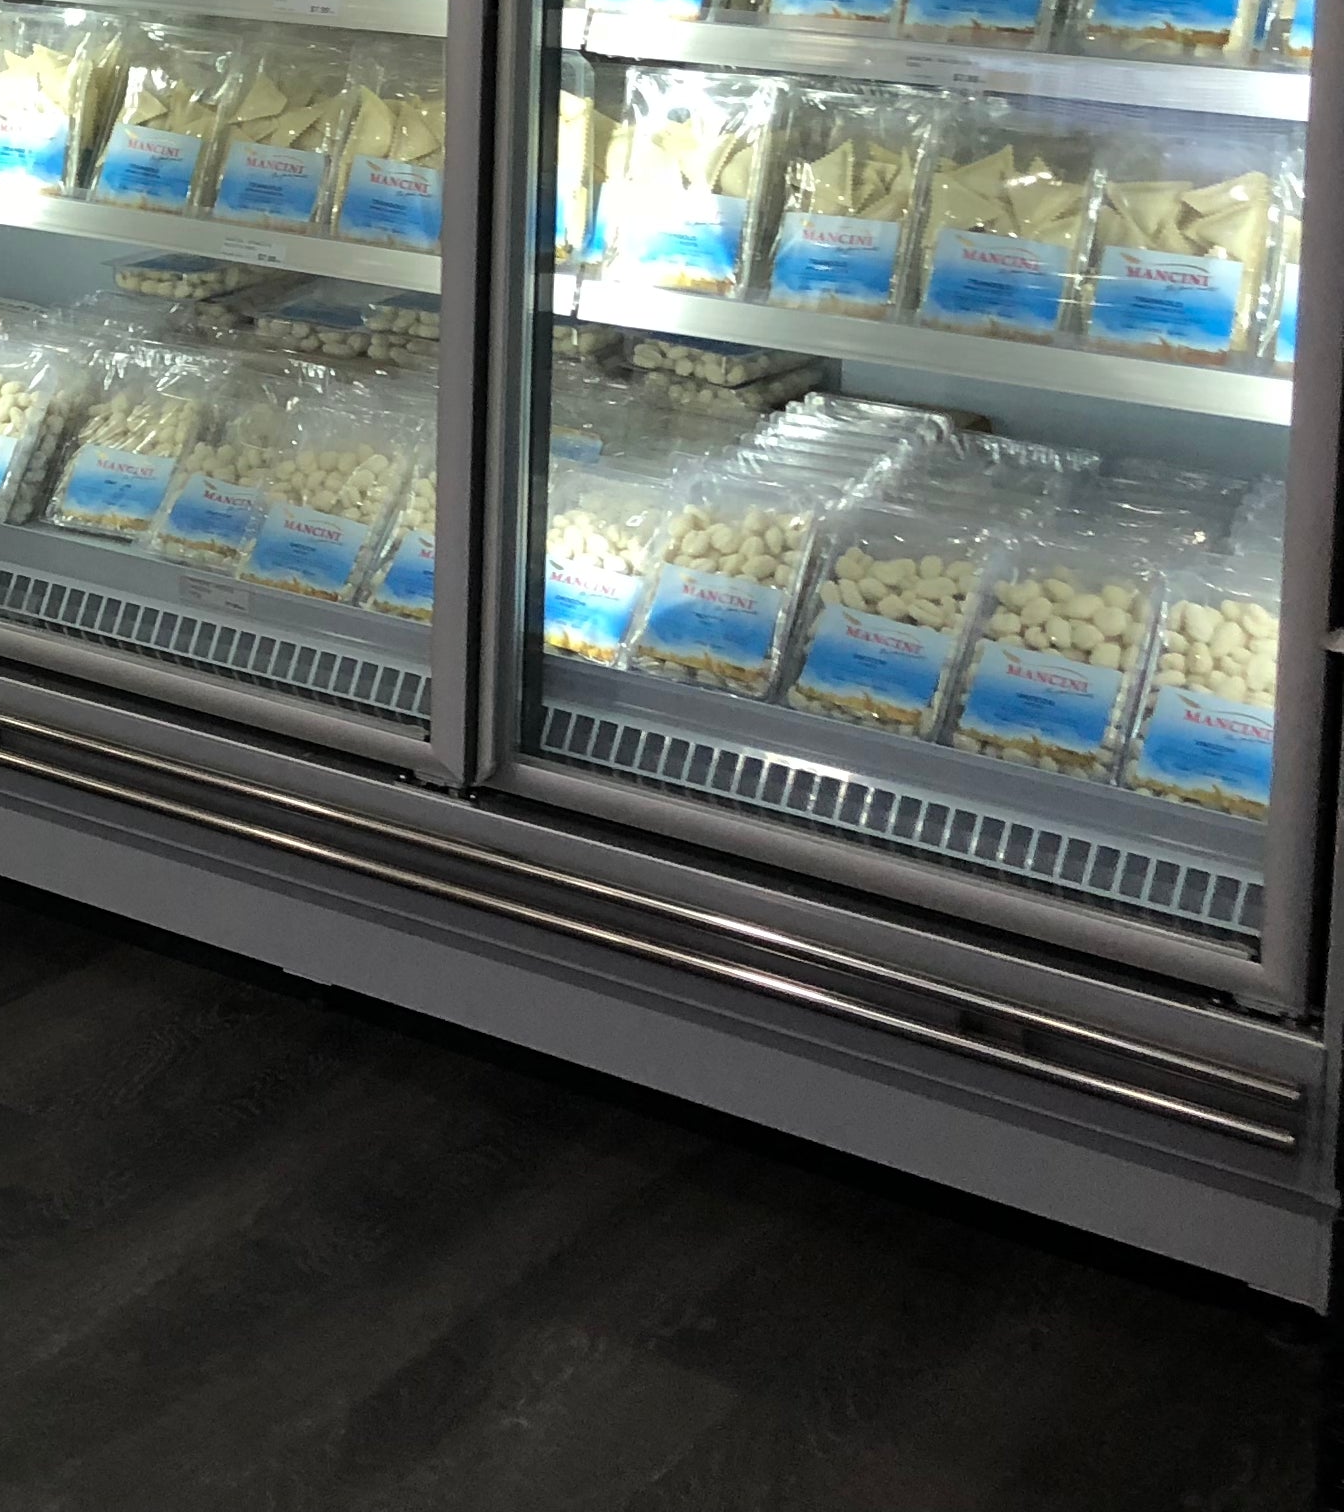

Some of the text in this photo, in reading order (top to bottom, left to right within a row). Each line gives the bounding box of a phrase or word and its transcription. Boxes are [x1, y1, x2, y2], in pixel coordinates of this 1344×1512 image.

[127, 139, 181, 157] MANCINI
[247, 156, 305, 174] MANCINI
[370, 173, 430, 194] MANCINI
[801, 228, 873, 246] MANCINI
[963, 248, 1041, 272] MANCINI
[1126, 265, 1211, 287] MANCINI
[96, 458, 156, 477] MANCINI
[284, 519, 343, 542] MANCINI
[549, 570, 617, 597] MANCINI
[681, 583, 757, 611] MANCINI
[845, 625, 923, 655] MANCINI
[1006, 663, 1089, 694] MANCINI
